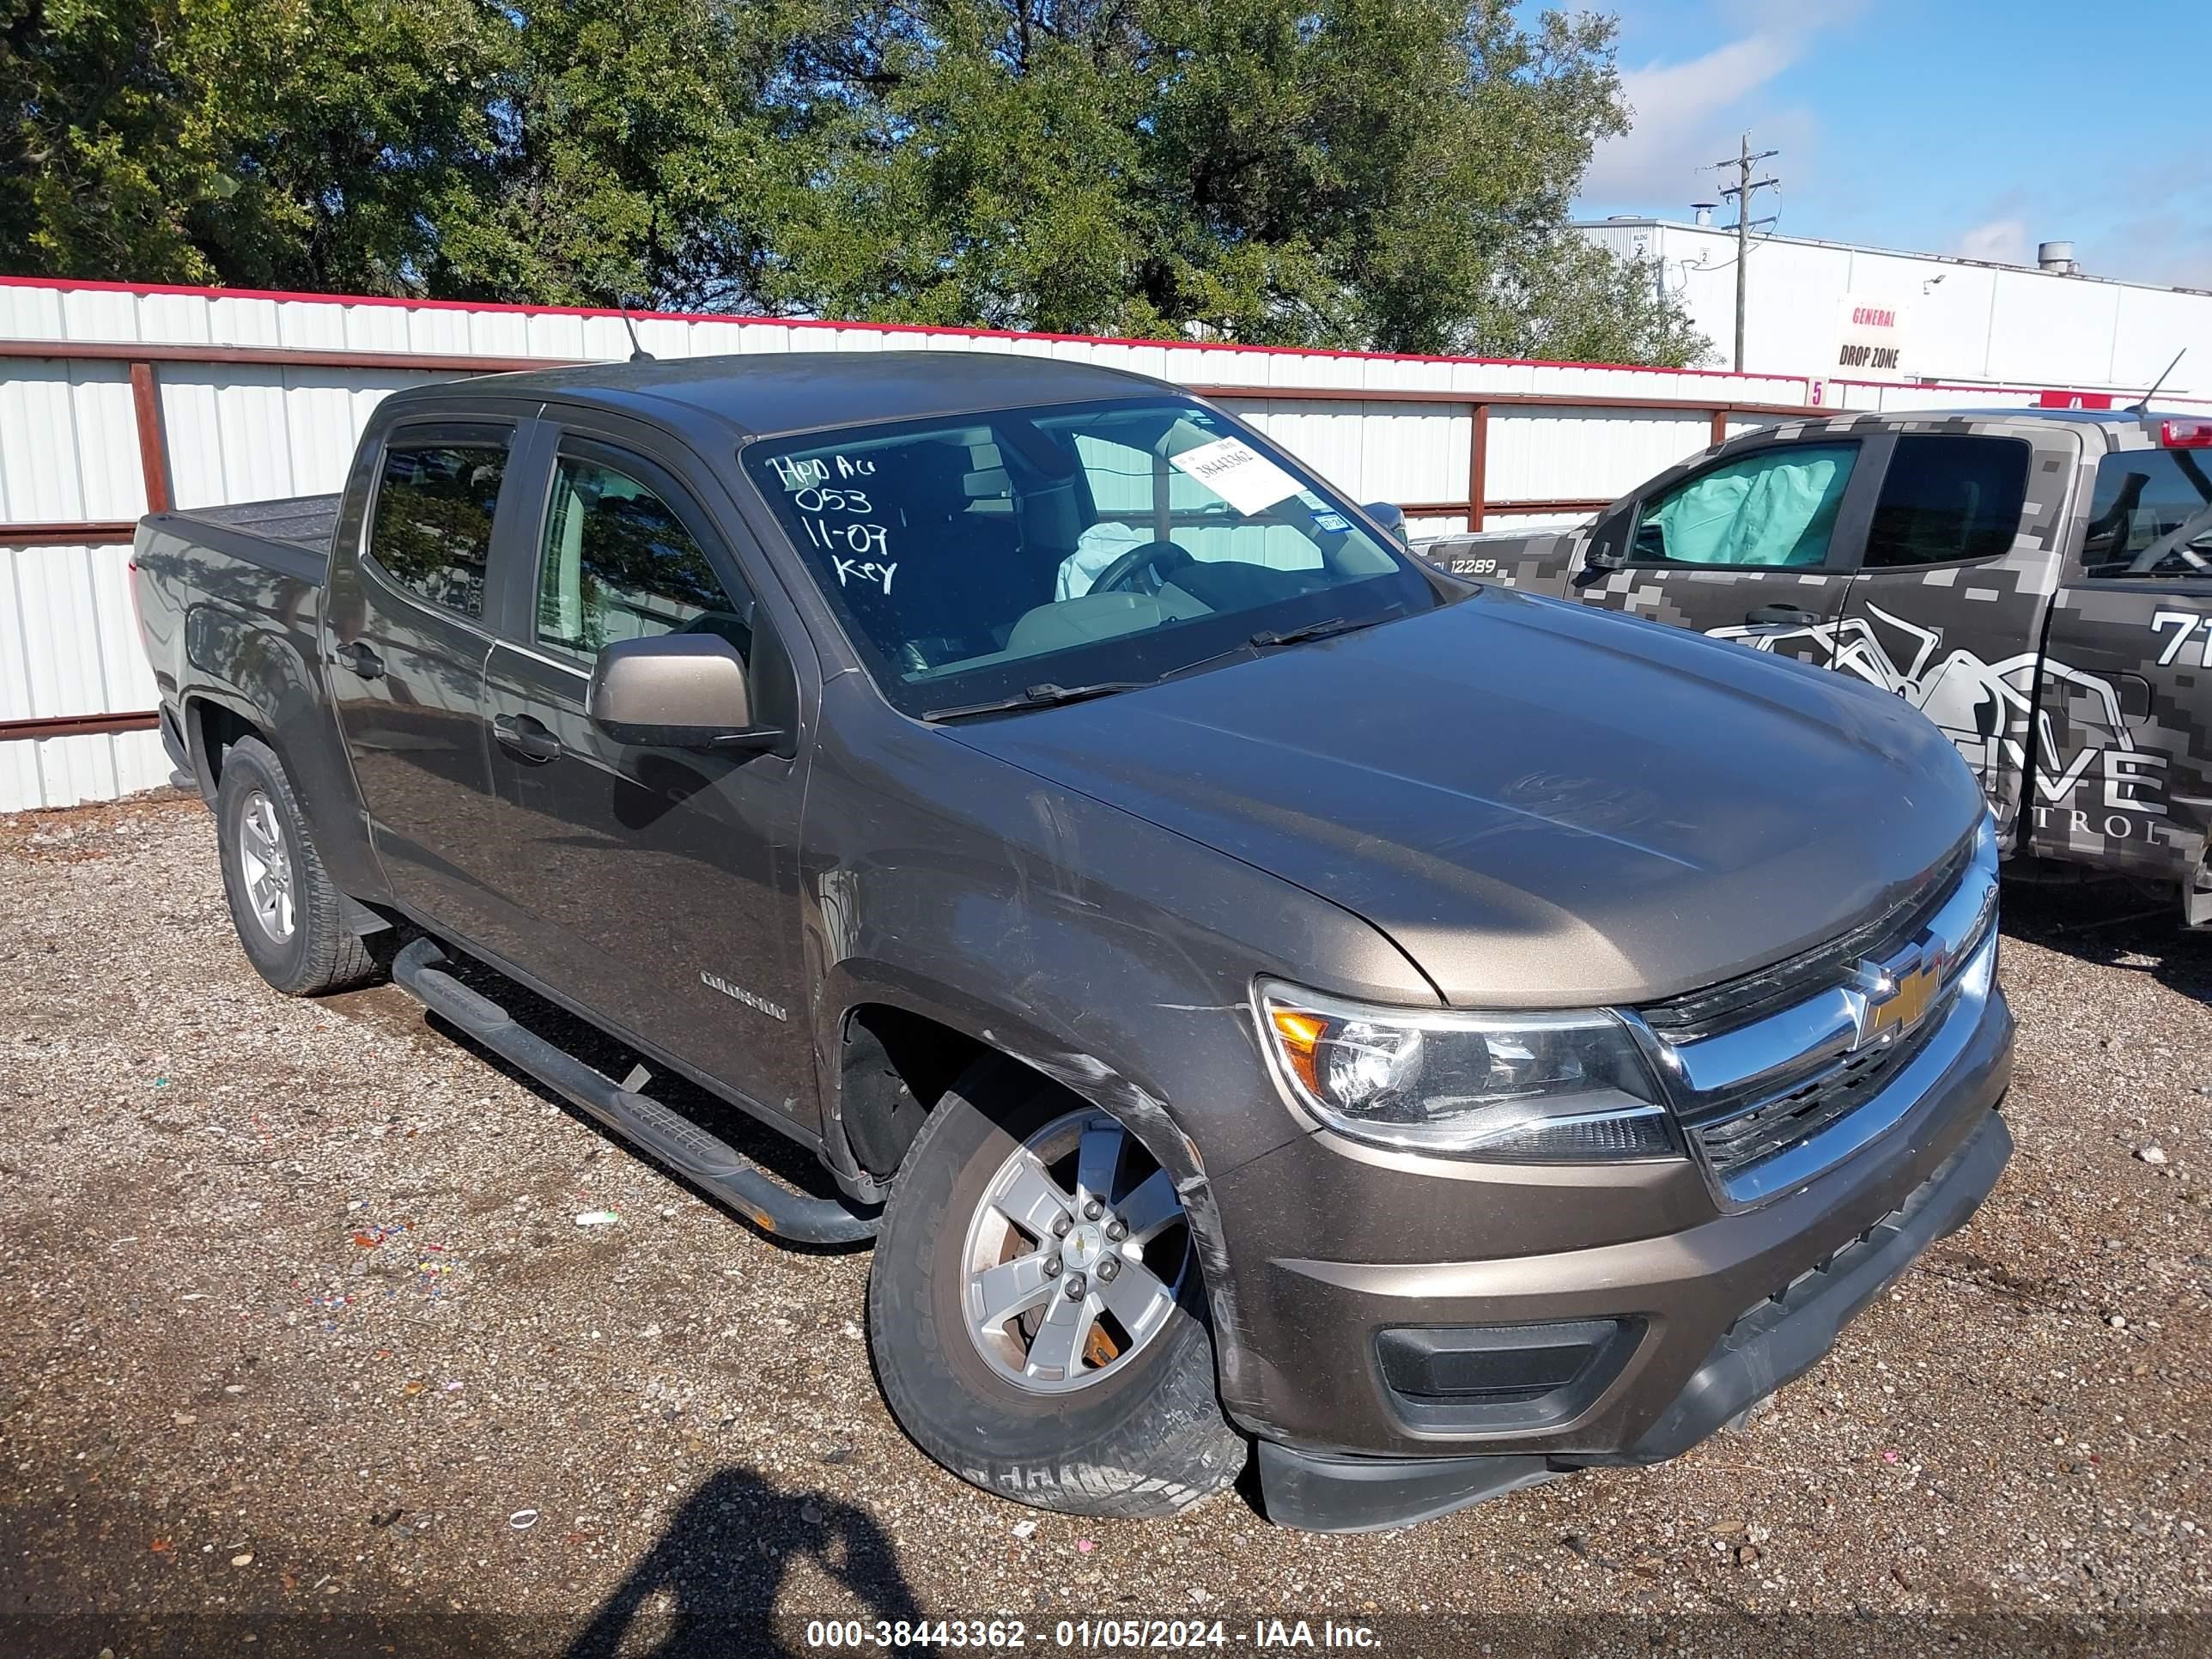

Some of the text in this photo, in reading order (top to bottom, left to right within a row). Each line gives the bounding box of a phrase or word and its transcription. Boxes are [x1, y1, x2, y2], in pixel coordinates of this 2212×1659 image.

[1702, 252, 1708, 262] 2
[1852, 307, 1896, 328] GENERAL
[1839, 344, 1900, 369] DROP ZONE
[1812, 381, 1822, 405] 5
[1195, 450, 1255, 478] 38443362
[795, 488, 872, 514] 053
[800, 515, 888, 556] 11-07
[1450, 559, 1497, 574] 12289
